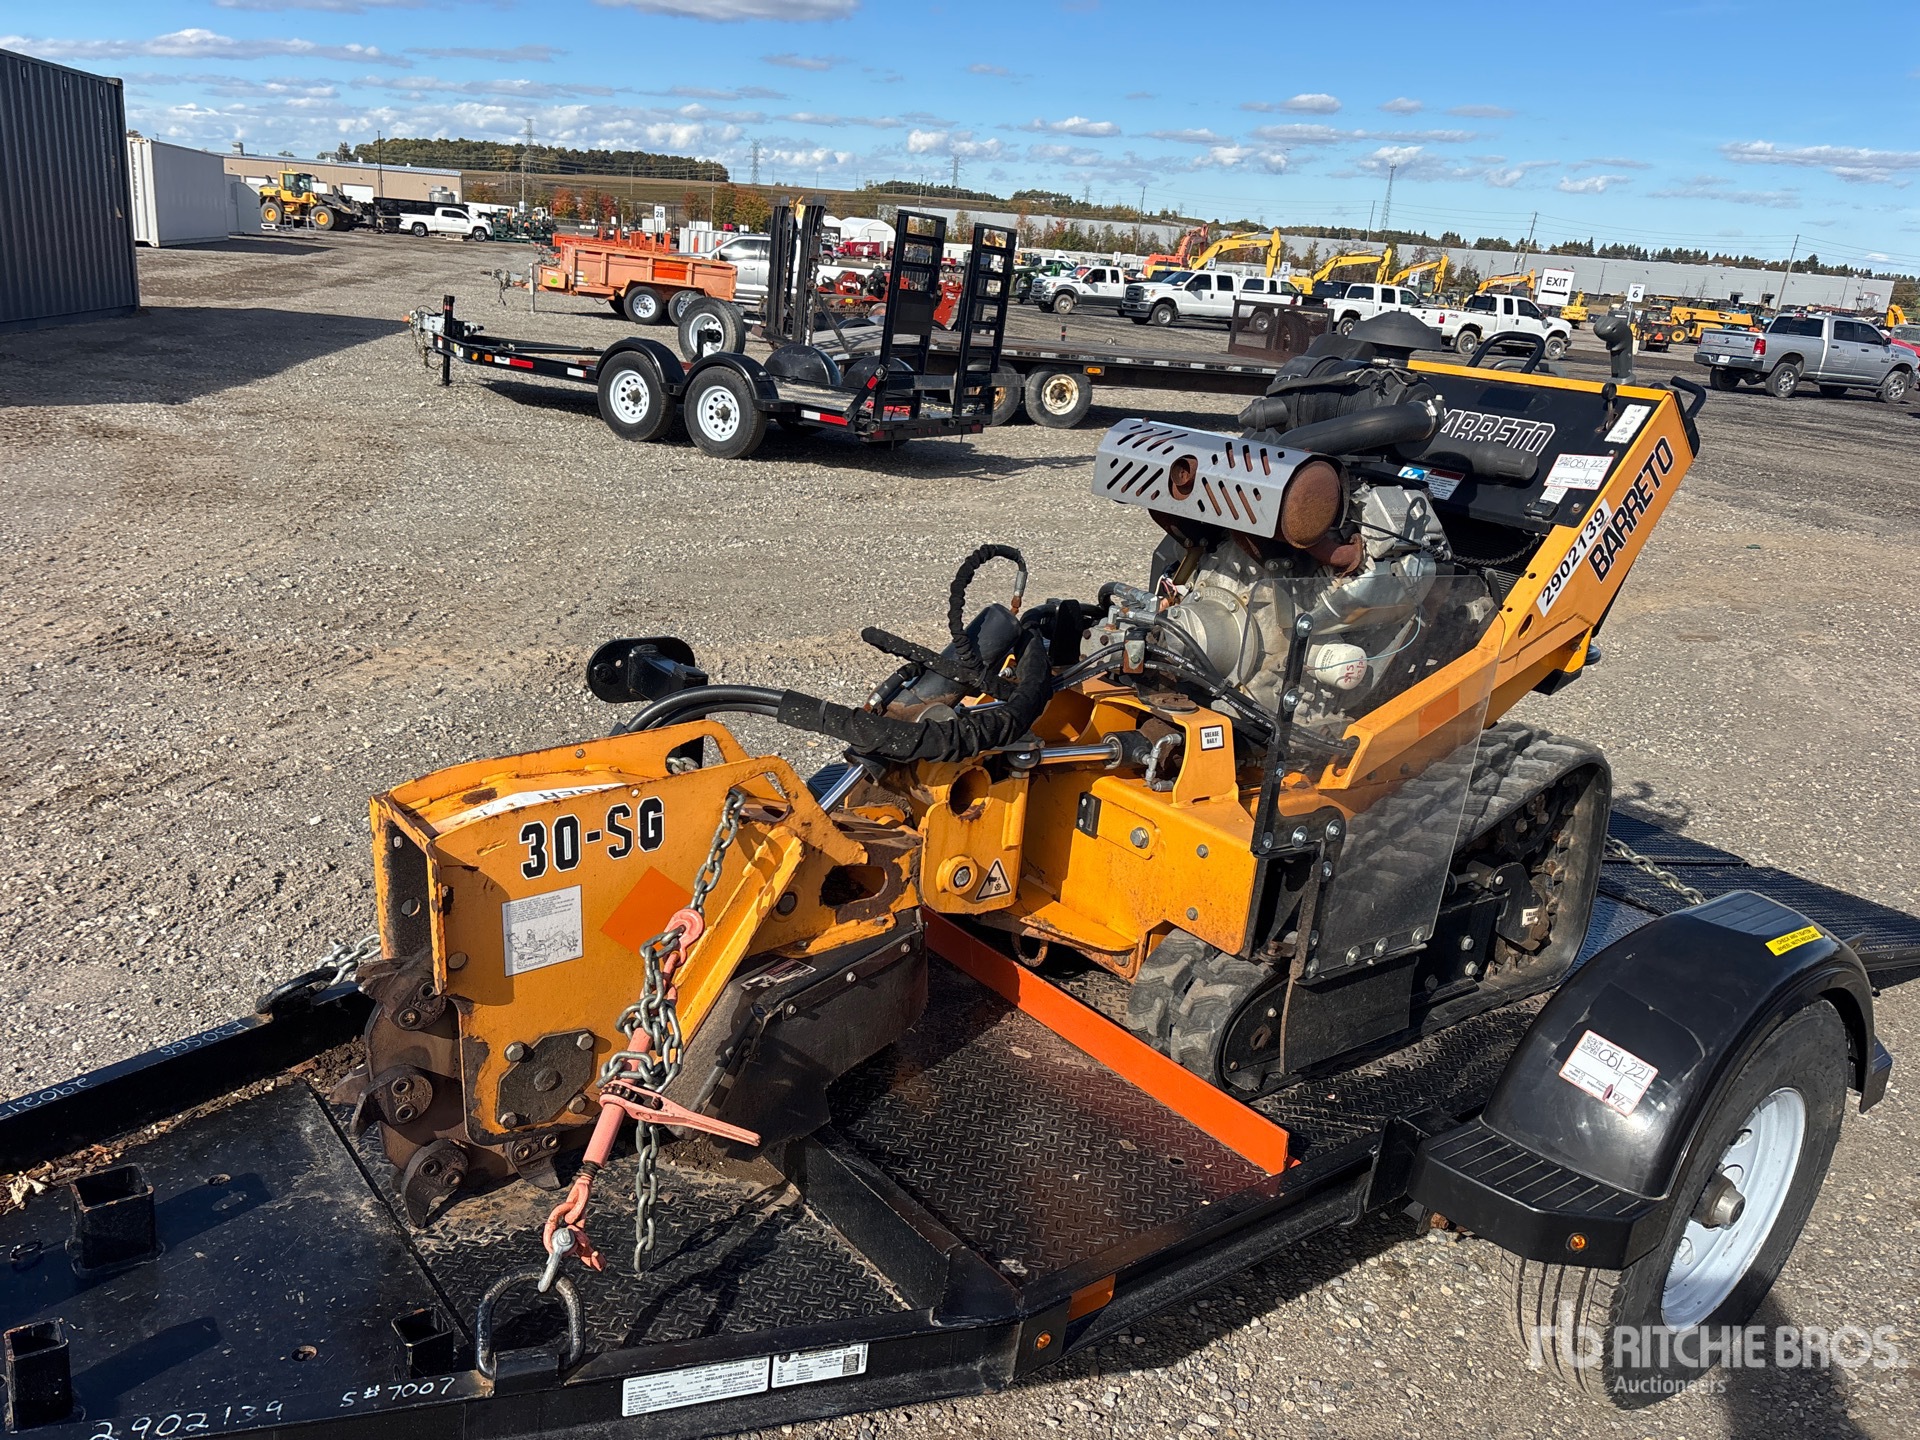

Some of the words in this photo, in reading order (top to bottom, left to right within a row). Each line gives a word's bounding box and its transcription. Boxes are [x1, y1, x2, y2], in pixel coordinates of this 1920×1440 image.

[656, 211, 664, 219] 28
[1545, 276, 1568, 288] EXIT
[1632, 289, 1639, 299] 6
[1440, 408, 1556, 457] ARRETO
[1587, 435, 1674, 584] BARRETO
[1542, 507, 1606, 607] 2902139
[1204, 730, 1220, 738] GREASE
[1206, 737, 1218, 745] DAILY
[519, 796, 665, 880] 30-SG
[1598, 1048, 1650, 1082] 051-221
